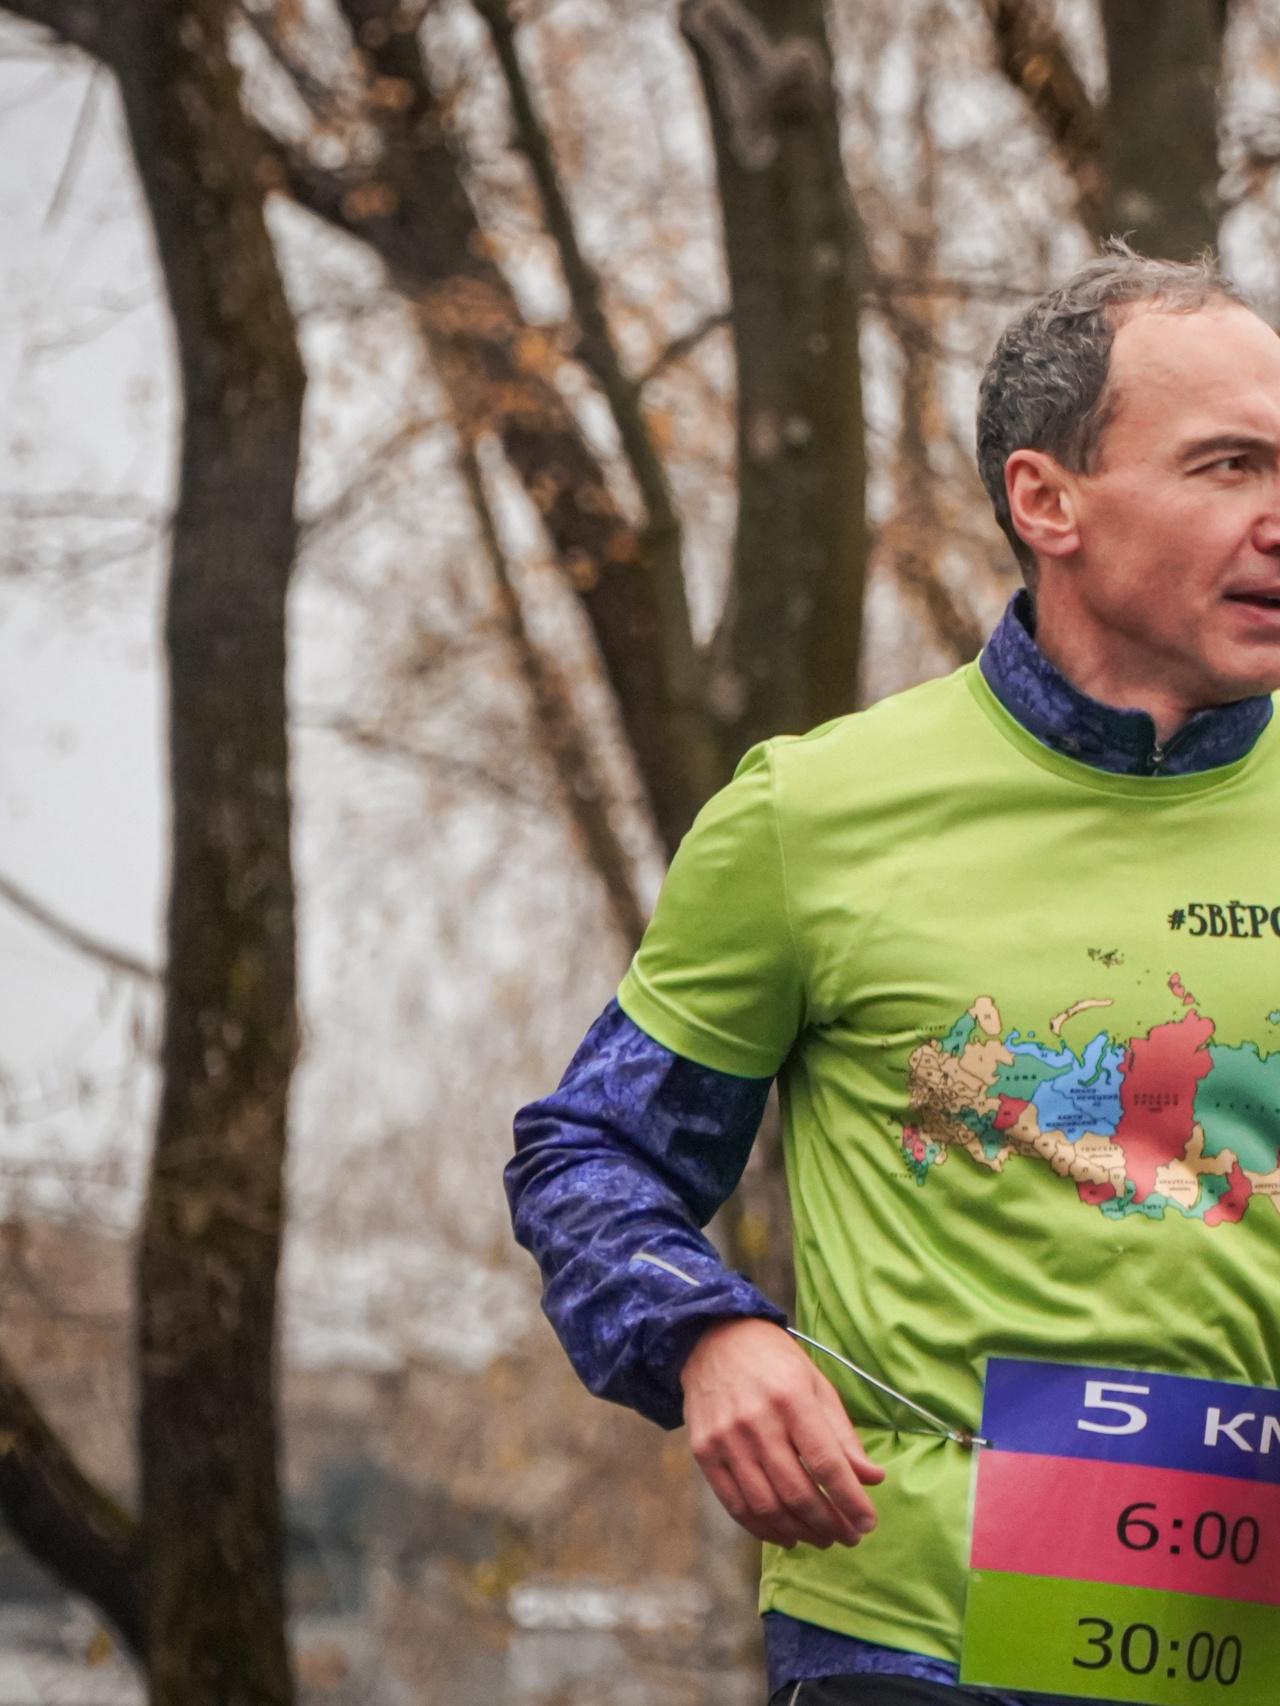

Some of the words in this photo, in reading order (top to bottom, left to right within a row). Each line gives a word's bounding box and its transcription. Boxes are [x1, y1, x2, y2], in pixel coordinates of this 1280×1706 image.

[1077, 1380, 1150, 1435] 5
[1116, 1502, 1260, 1566] 6:00
[1072, 1617, 1242, 1686] 30:00
